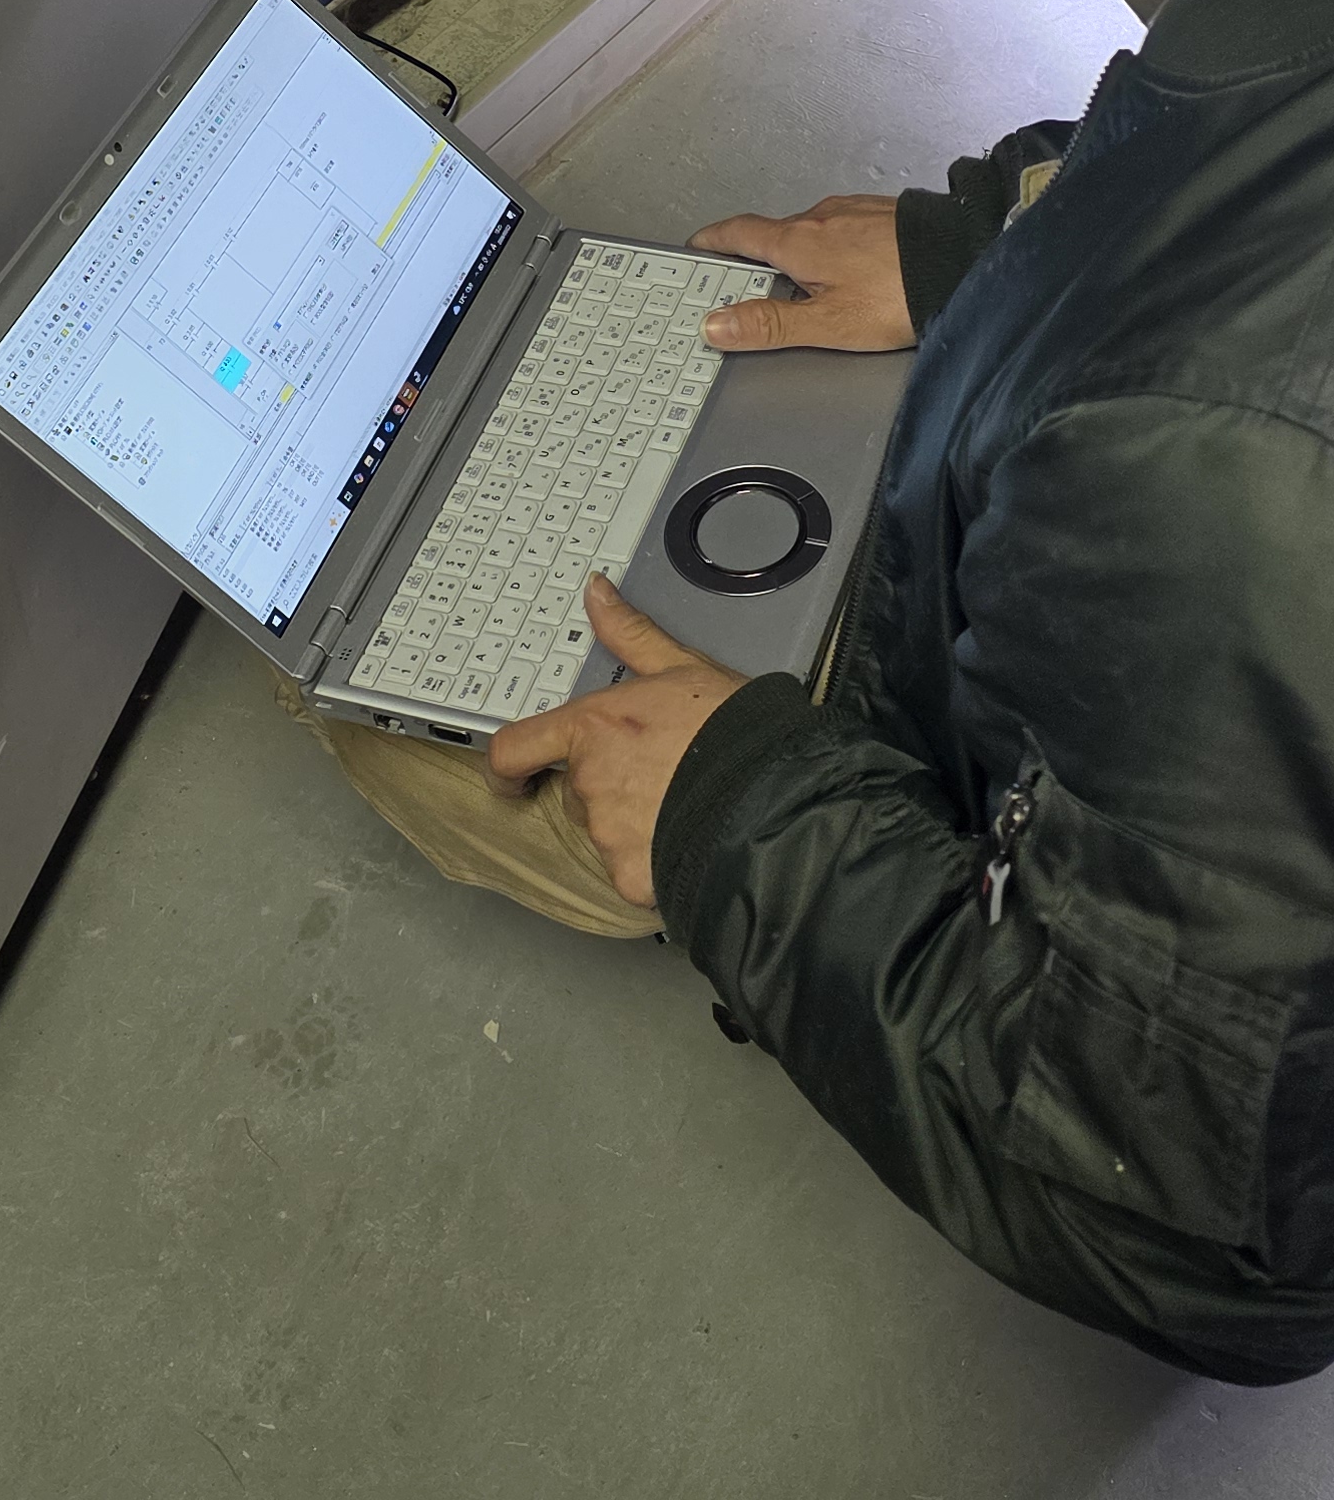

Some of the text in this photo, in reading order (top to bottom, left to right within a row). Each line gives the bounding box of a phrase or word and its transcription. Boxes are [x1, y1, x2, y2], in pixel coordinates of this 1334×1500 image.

[635, 261, 648, 278] Enter
[693, 362, 703, 373] Ctrl
[616, 438, 628, 446] M
[560, 480, 571, 488] H
[545, 513, 555, 521] G
[289, 552, 318, 599] ここに入力して検索
[537, 606, 548, 614] X
[452, 615, 465, 626] W
[435, 654, 447, 662] Q
[475, 653, 486, 661] A
[361, 663, 372, 674] Esc
[553, 664, 564, 676] Ctrl
[421, 676, 434, 689] Tab
[458, 674, 476, 699] Caps Lock
[506, 675, 520, 692] Shift
